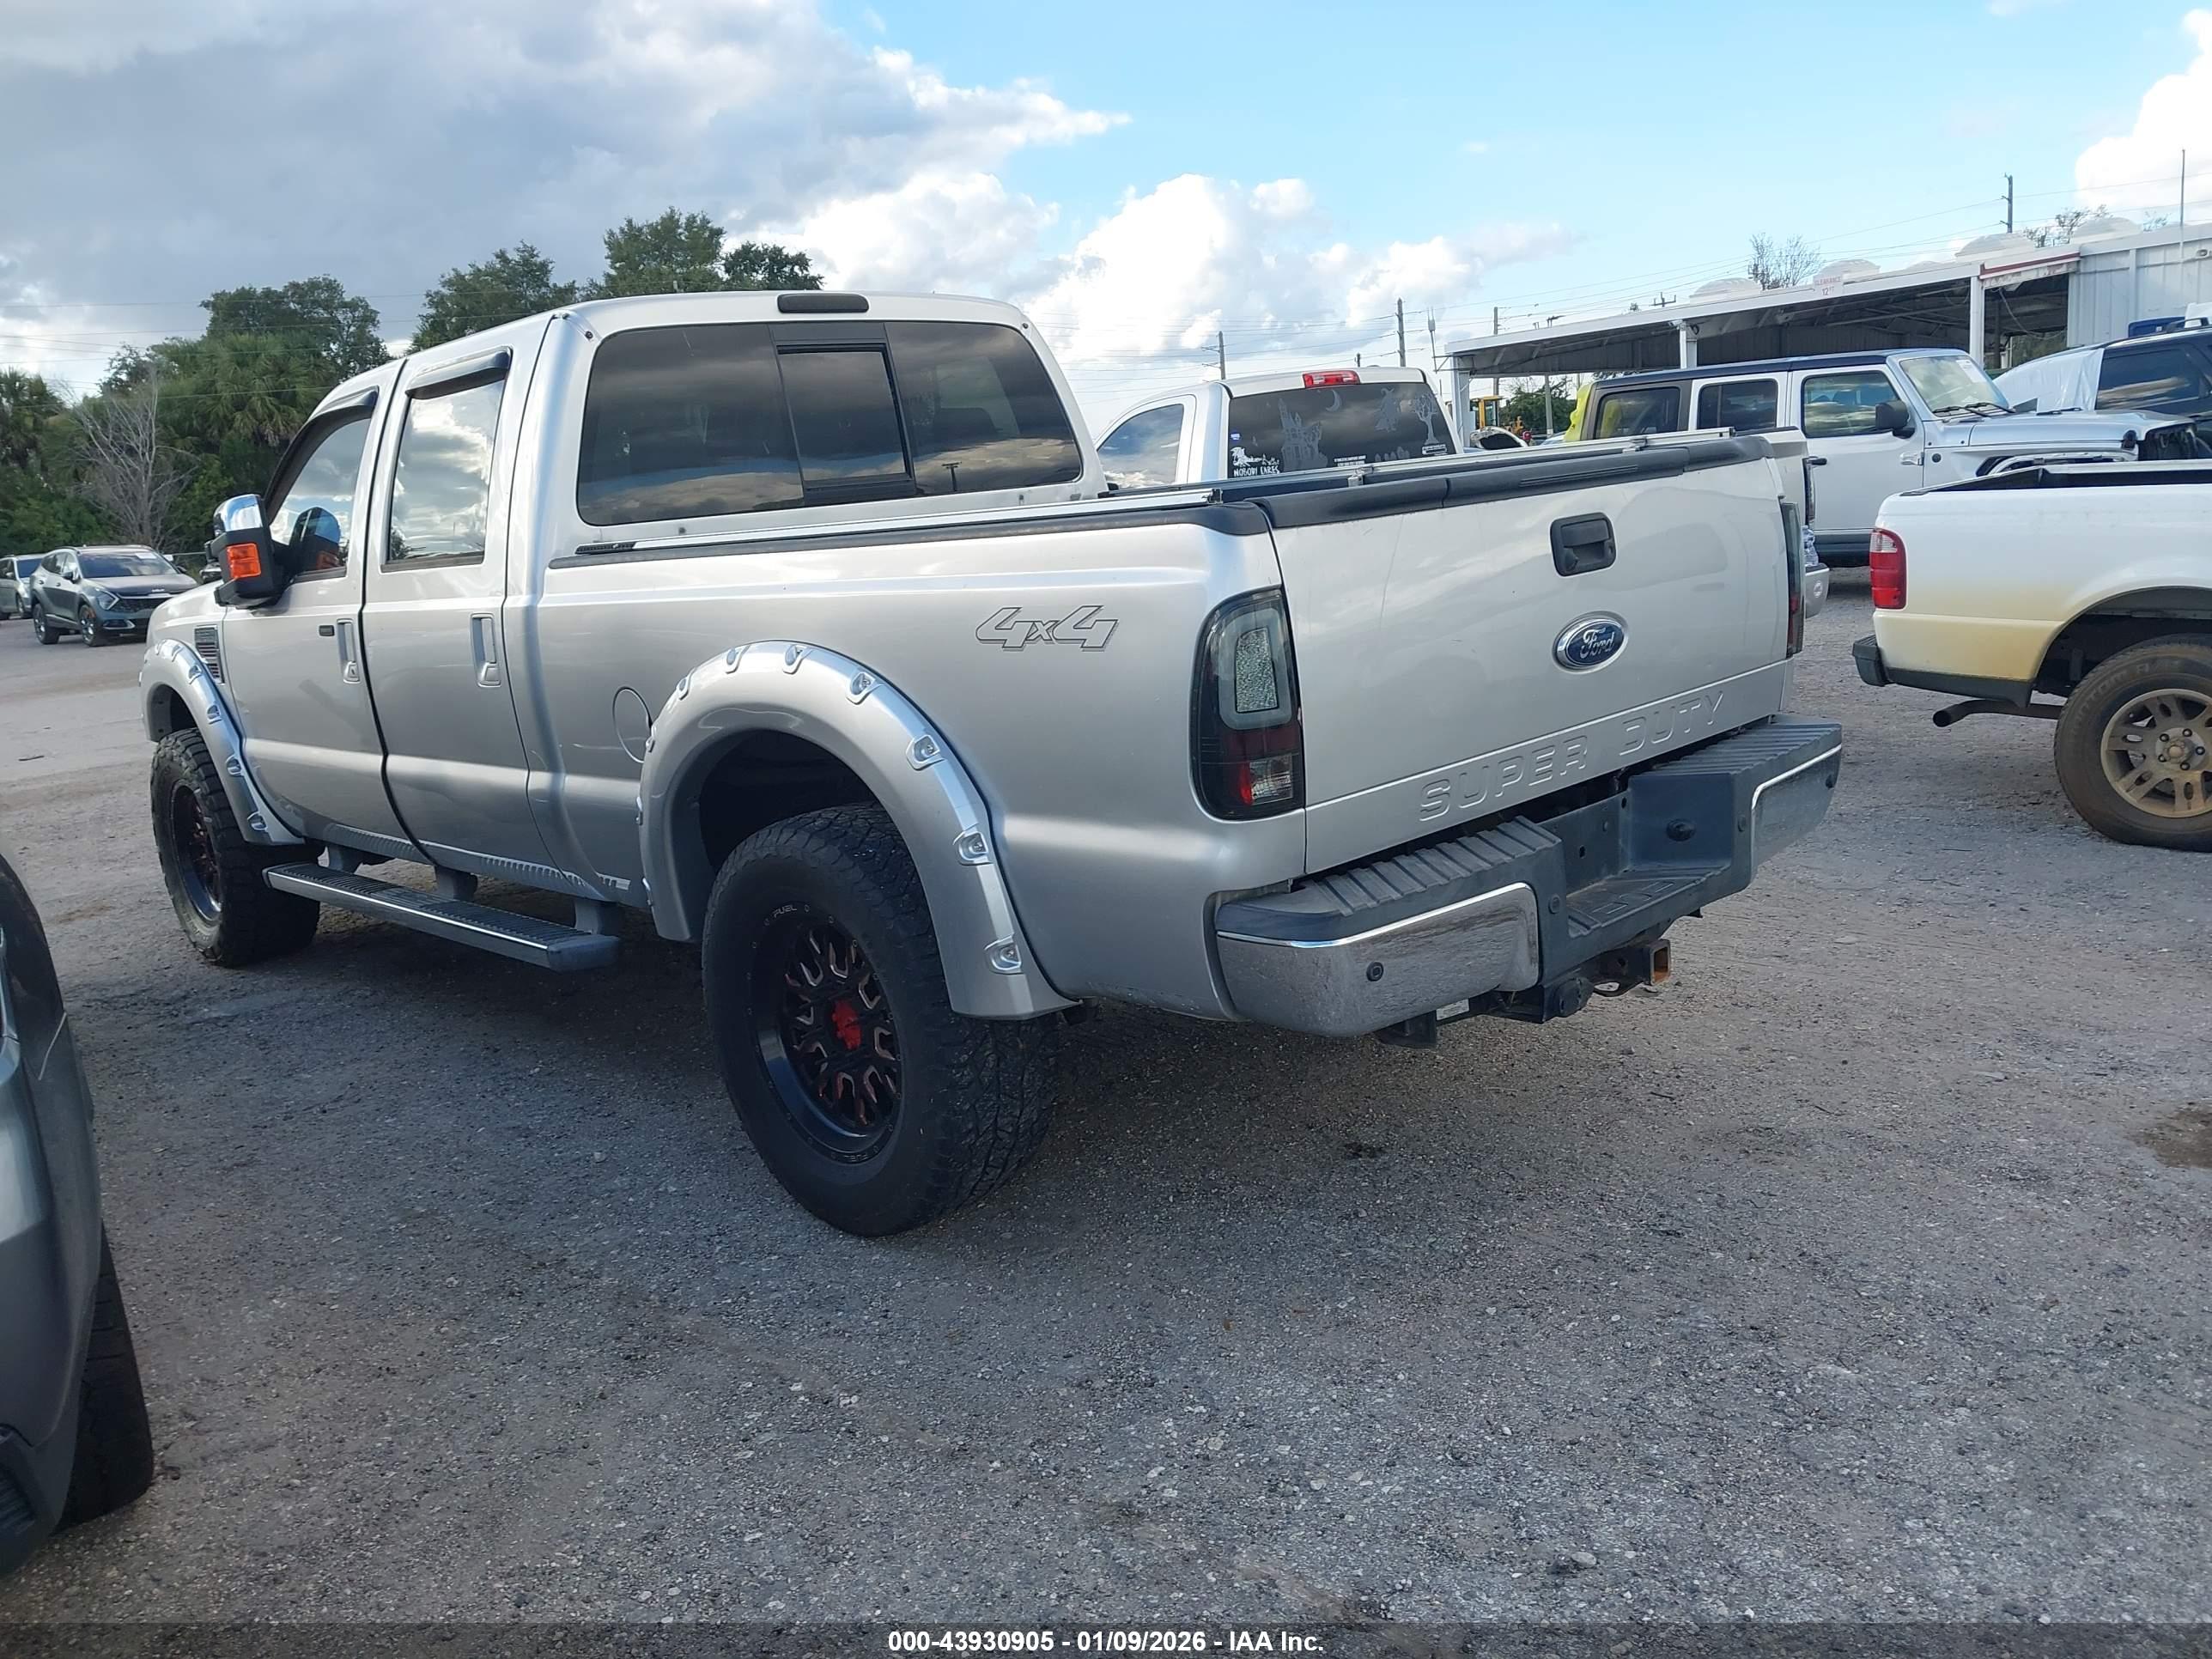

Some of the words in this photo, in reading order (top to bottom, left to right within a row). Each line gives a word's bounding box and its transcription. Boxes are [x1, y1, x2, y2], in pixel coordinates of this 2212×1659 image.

[1233, 467, 1258, 477] NOBODY
[1261, 465, 1280, 475] CARES
[975, 605, 1119, 649] 4x4
[1580, 627, 1615, 659] Ford
[1419, 734, 1588, 822] SUPER
[1619, 690, 1724, 757] DUTY
[773, 904, 798, 919] FUEL
